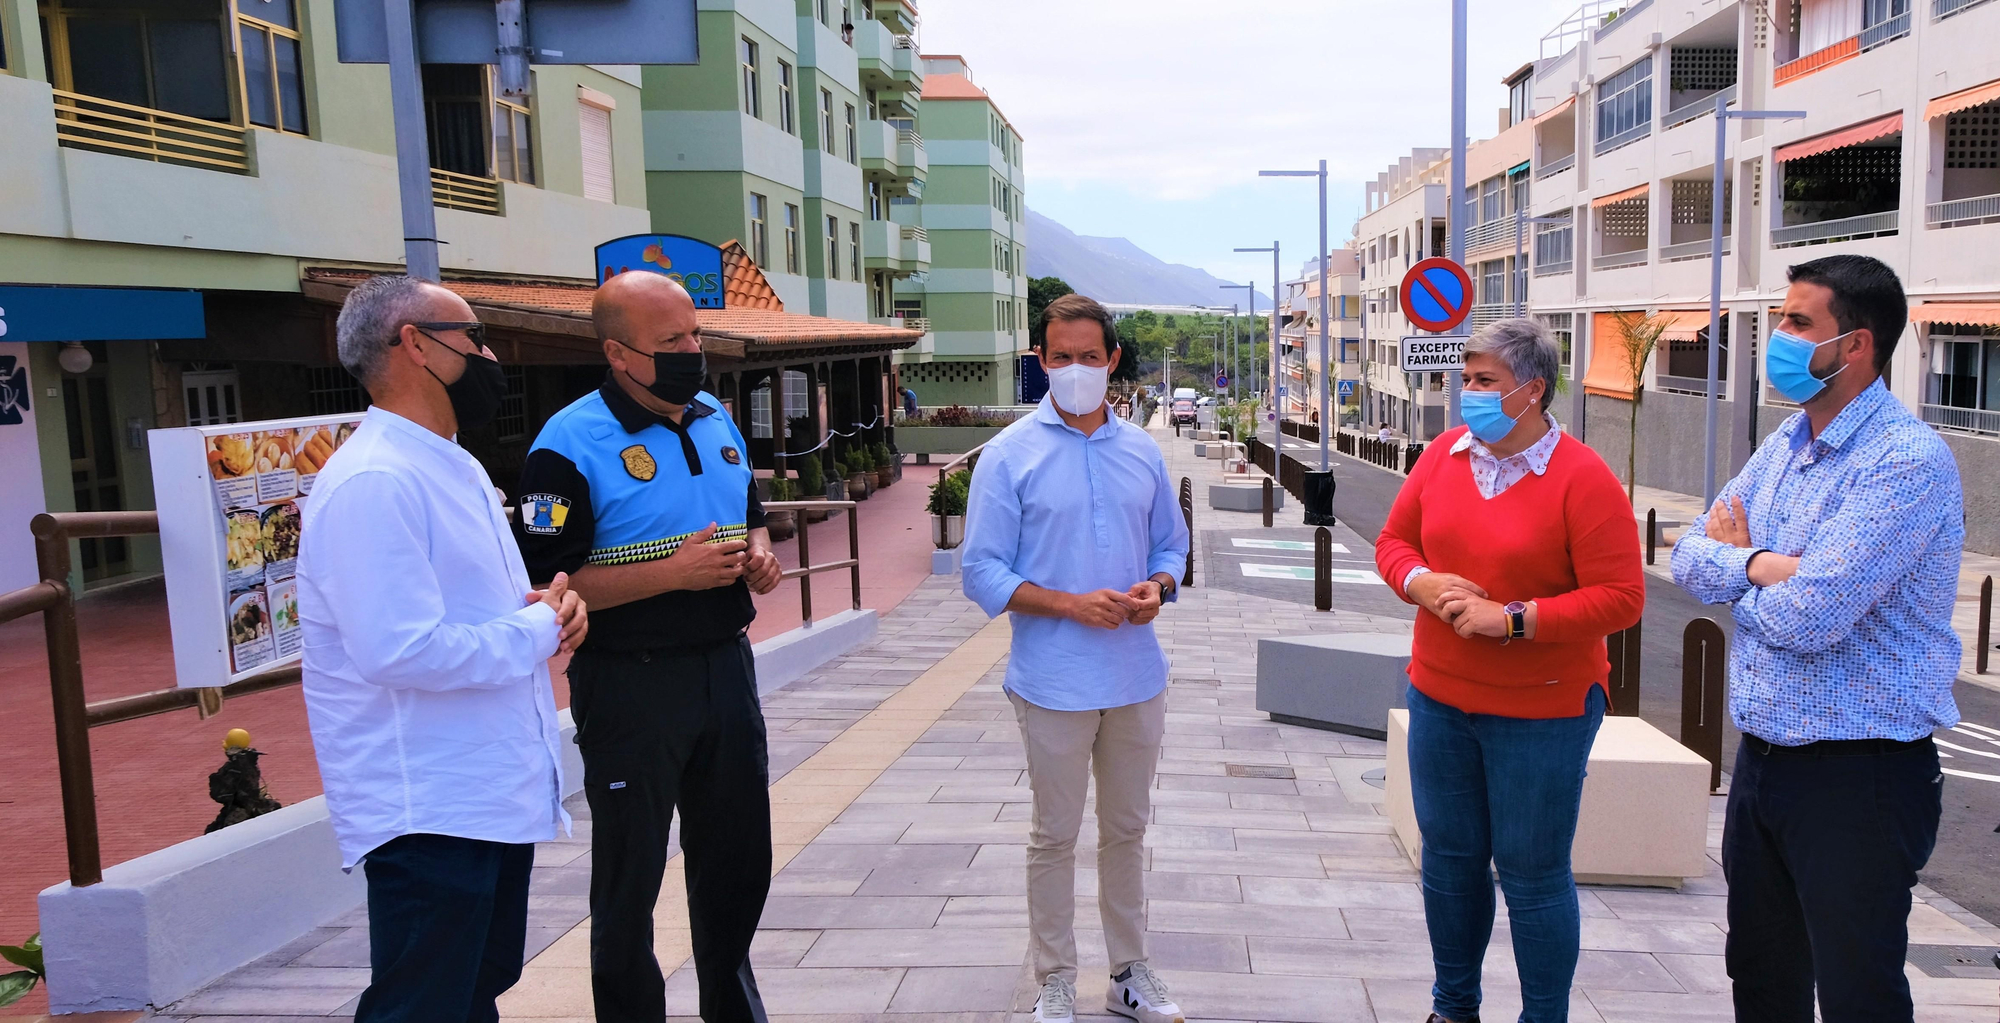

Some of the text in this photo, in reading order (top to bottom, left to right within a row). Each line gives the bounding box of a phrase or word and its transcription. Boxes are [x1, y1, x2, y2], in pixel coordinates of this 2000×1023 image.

[1410, 342, 1465, 353] EXCEPTO
[1407, 354, 1463, 365] FARMACI
[527, 494, 562, 505] POLICIA
[528, 525, 557, 533] CANARIA
